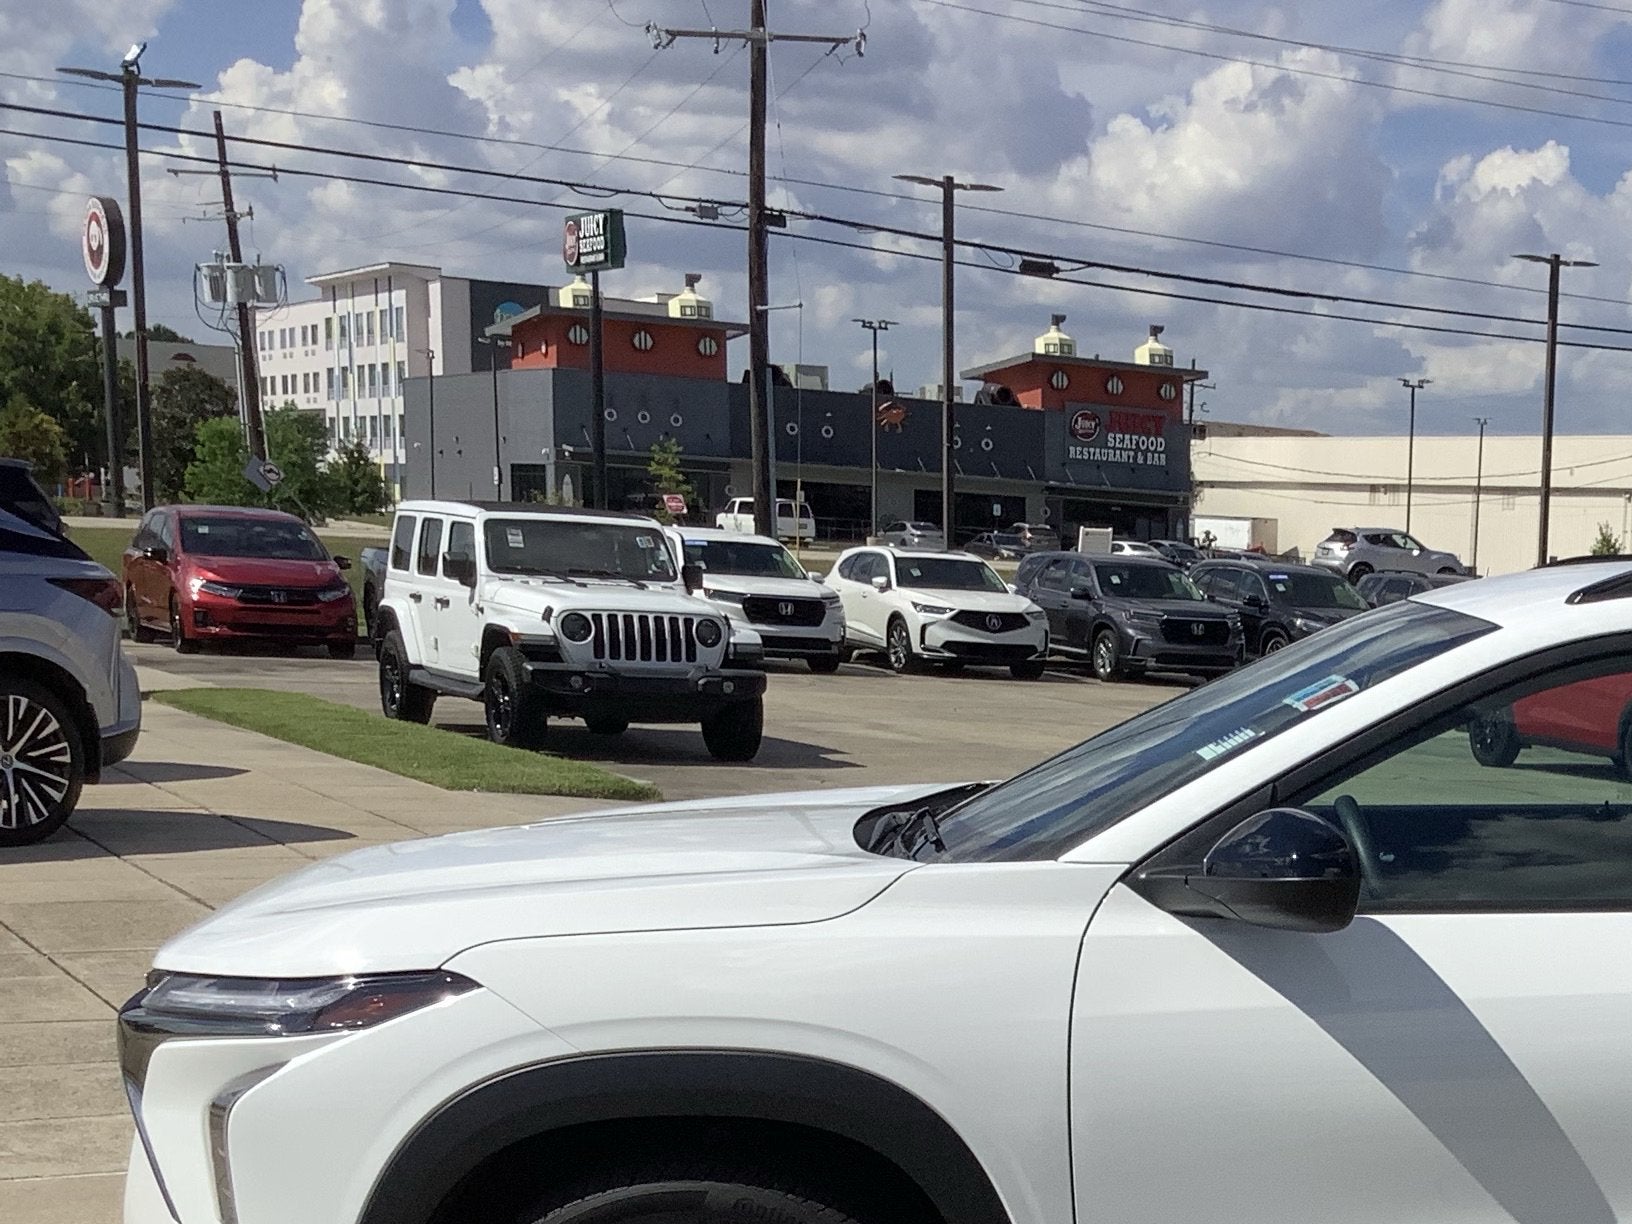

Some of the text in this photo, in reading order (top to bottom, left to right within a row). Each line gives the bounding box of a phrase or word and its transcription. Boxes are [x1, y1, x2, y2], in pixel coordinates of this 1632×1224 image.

[579, 213, 604, 238] JUICY
[579, 235, 605, 253] SEAFOOD
[1107, 433, 1166, 452] SEAFOOD
[1068, 446, 1166, 466] RESTAURANT & BAR
